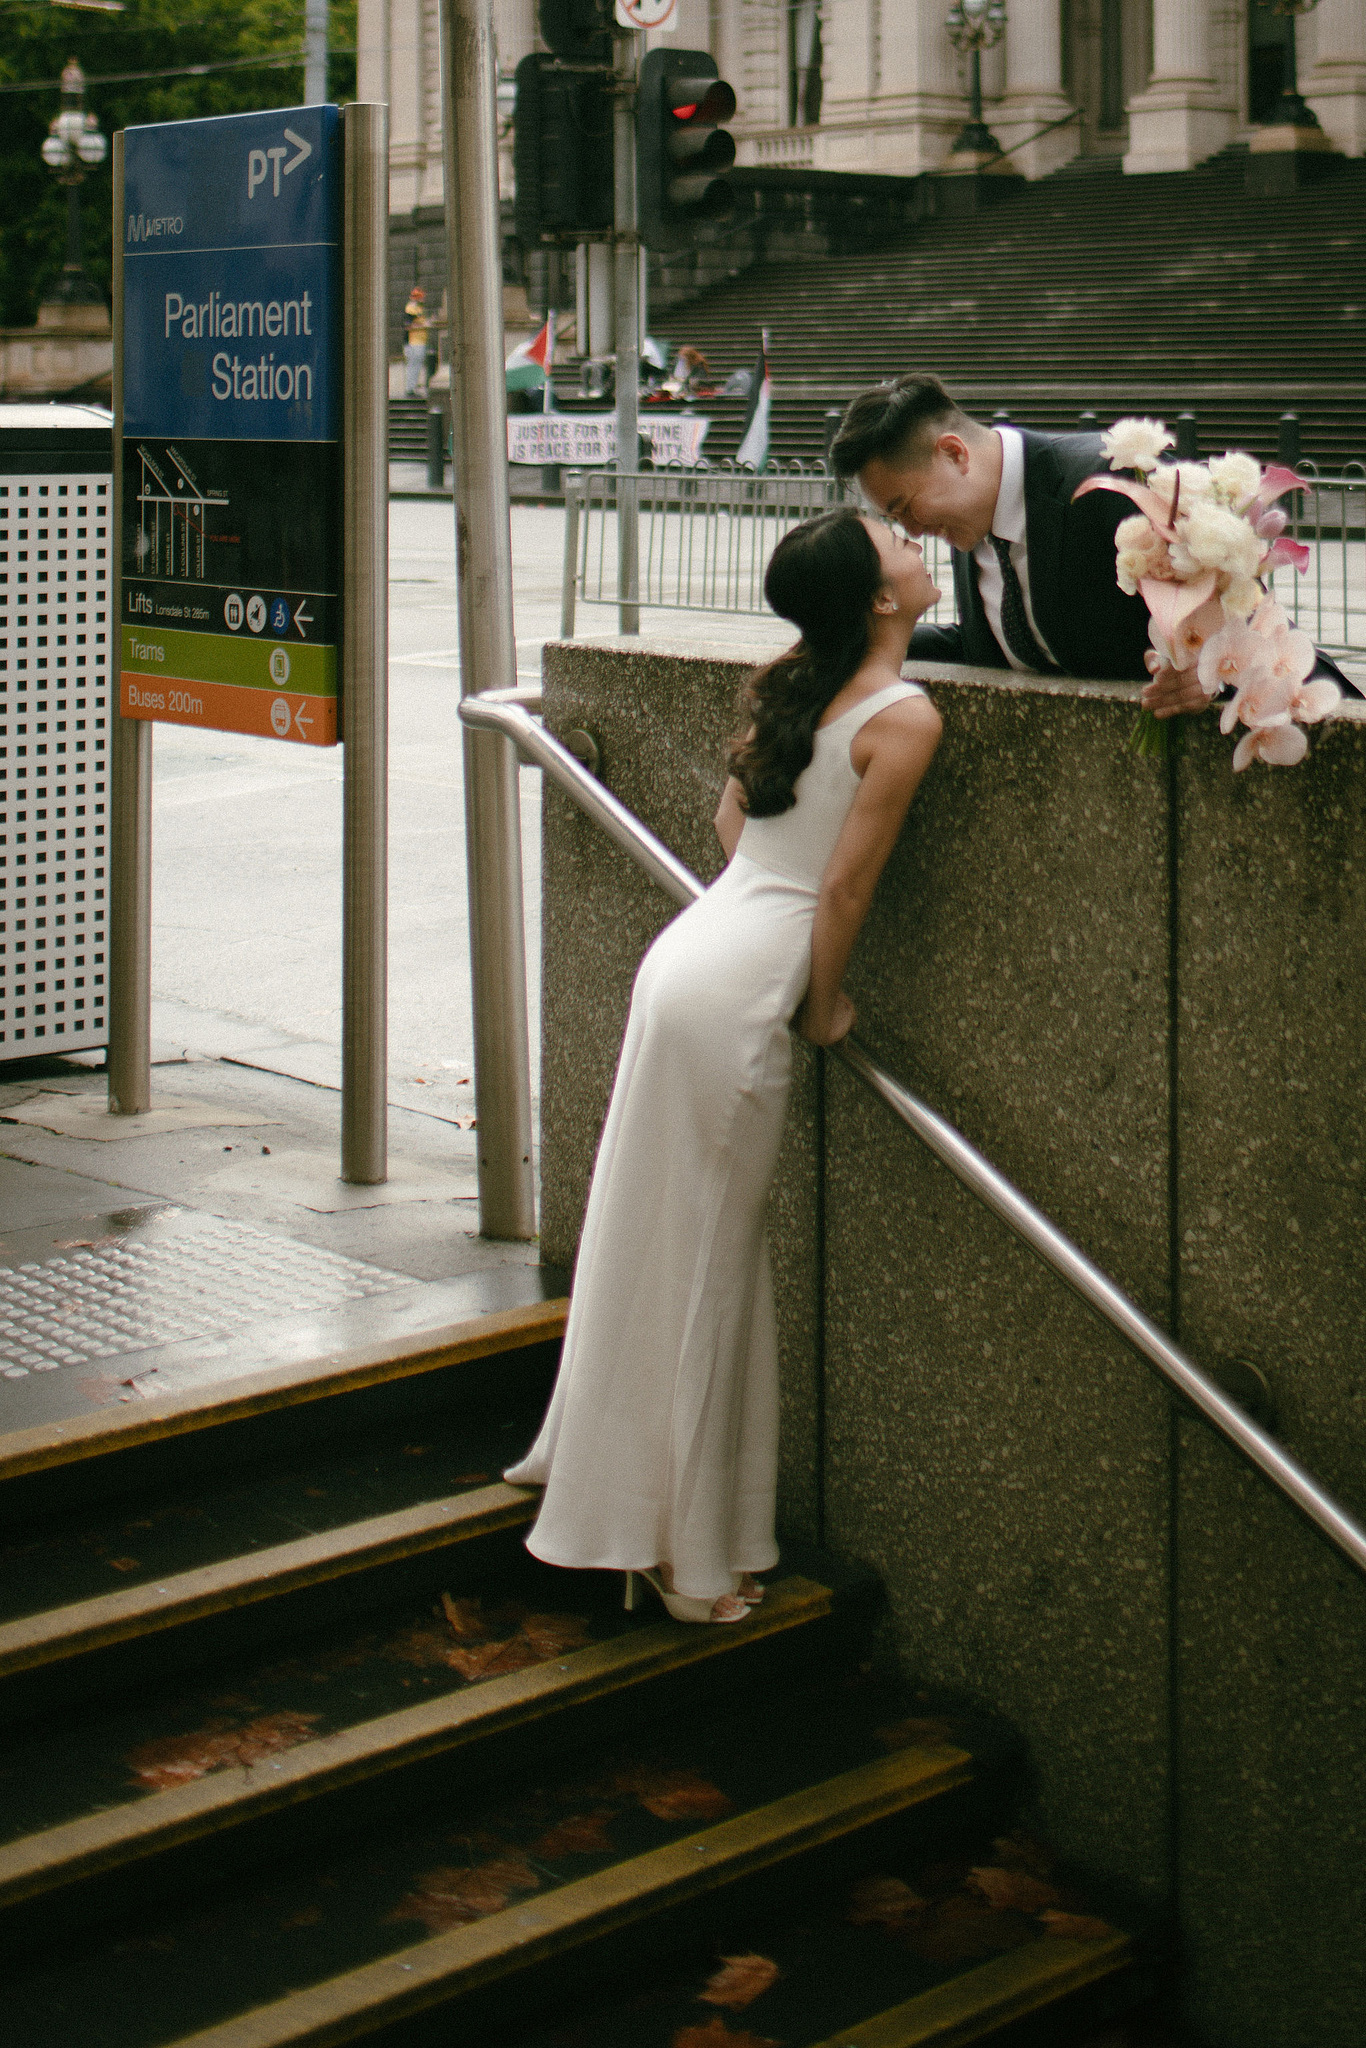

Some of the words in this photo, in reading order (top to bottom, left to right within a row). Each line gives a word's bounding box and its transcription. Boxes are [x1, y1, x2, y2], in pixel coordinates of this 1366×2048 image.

[146, 216, 184, 238] METRO
[165, 291, 312, 339] Parliament
[211, 352, 312, 401] Station
[517, 424, 568, 440] JUSTICE
[575, 424, 599, 440] FOR
[513, 443, 526, 459] IS
[531, 443, 570, 459] PEACE
[577, 442, 601, 458] FOR
[128, 591, 153, 615] Lifts
[155, 603, 183, 618] Lonsdale
[183, 606, 191, 619] St
[128, 638, 165, 662] Trams
[128, 685, 165, 710] Buses
[168, 690, 203, 716] 200m
